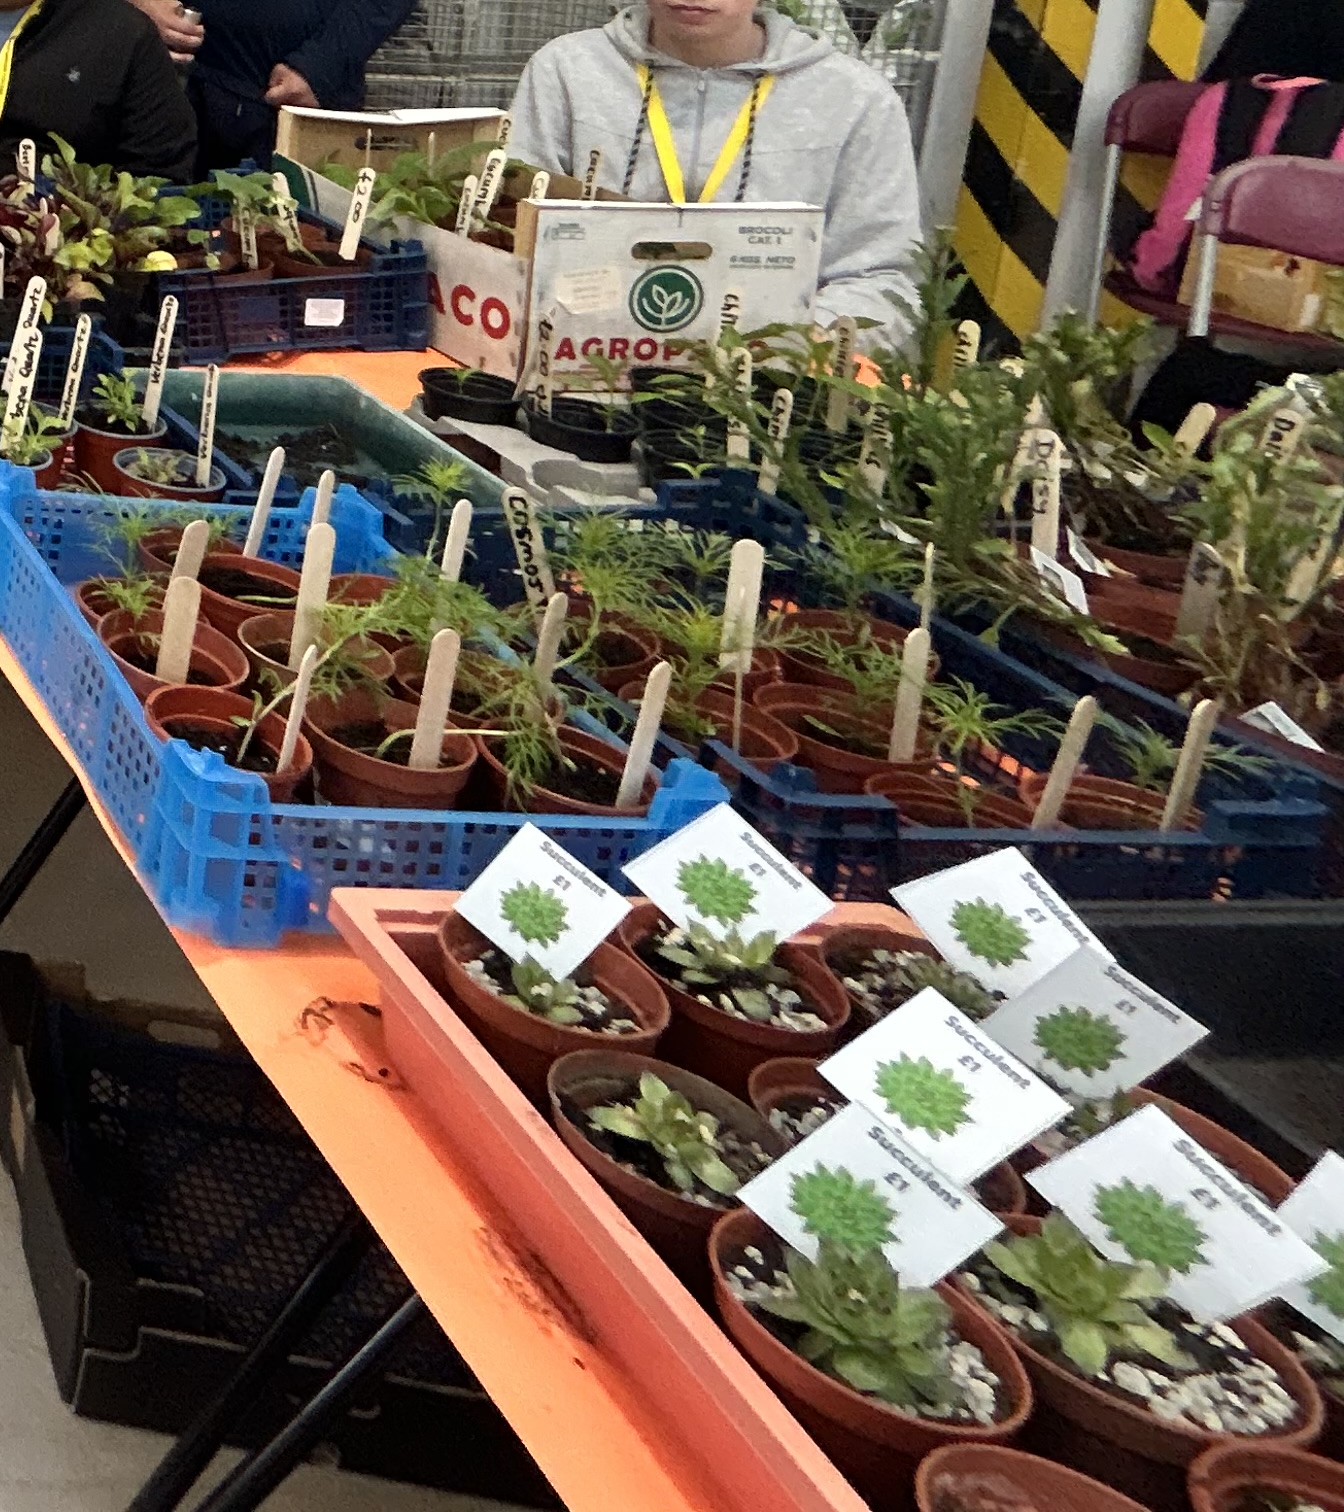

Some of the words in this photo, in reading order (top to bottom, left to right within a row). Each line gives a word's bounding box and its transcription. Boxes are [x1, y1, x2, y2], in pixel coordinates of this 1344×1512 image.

[427, 271, 511, 340] ACO
[539, 839, 608, 899] Succulent
[739, 831, 804, 891] Succulent
[1020, 870, 1092, 945] Succulent
[1103, 964, 1182, 1025] Succulent
[943, 1014, 1033, 1091] Succulent
[956, 1053, 983, 1074] £1
[865, 1124, 964, 1211] Succulent
[882, 1170, 911, 1193] £1
[1173, 1138, 1283, 1238] Succulent
